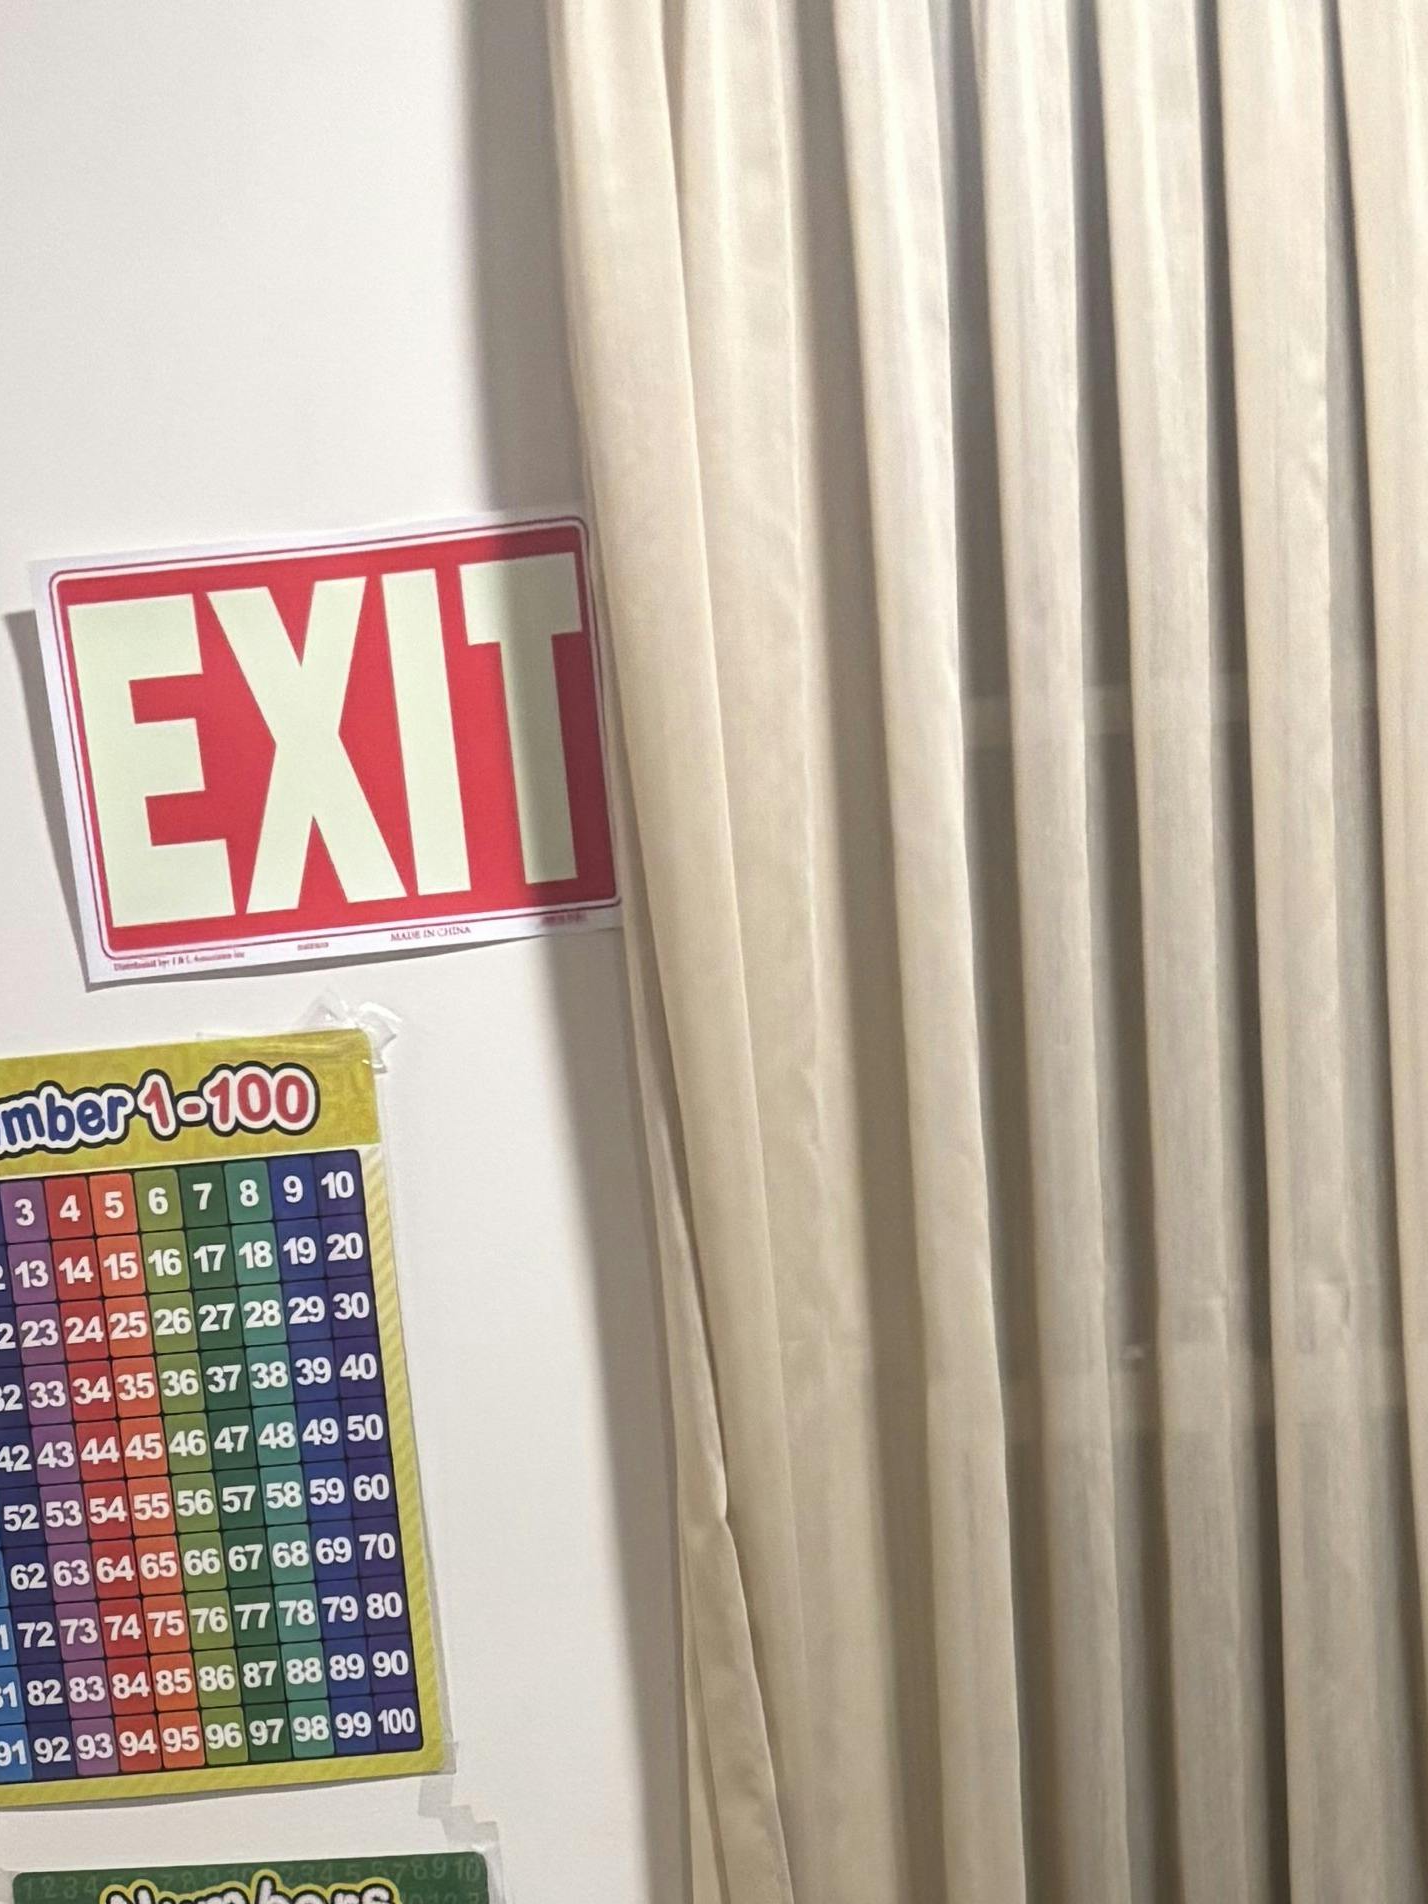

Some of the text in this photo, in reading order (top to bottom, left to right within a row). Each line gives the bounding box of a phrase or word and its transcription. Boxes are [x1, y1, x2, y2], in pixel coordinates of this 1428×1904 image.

[67, 551, 583, 928] EXIT
[390, 926, 471, 942] MADE IN CHINA
[138, 1064, 316, 1135] 1-100
[14, 1198, 36, 1227] 3
[59, 1194, 81, 1222] 4
[104, 1190, 125, 1219] 5
[148, 1186, 169, 1215] 6
[192, 1182, 213, 1211] 7
[239, 1179, 260, 1208] 8
[282, 1175, 304, 1203] 9
[320, 1170, 355, 1200] 10
[33, 1736, 72, 1764] 92
[76, 1732, 114, 1761] 93
[119, 1729, 158, 1757] 94
[162, 1725, 200, 1753] 95
[204, 1722, 243, 1750] 96
[249, 1718, 285, 1746] 97
[292, 1714, 330, 1743] 98
[335, 1711, 372, 1739] 99
[377, 1707, 416, 1735] 100
